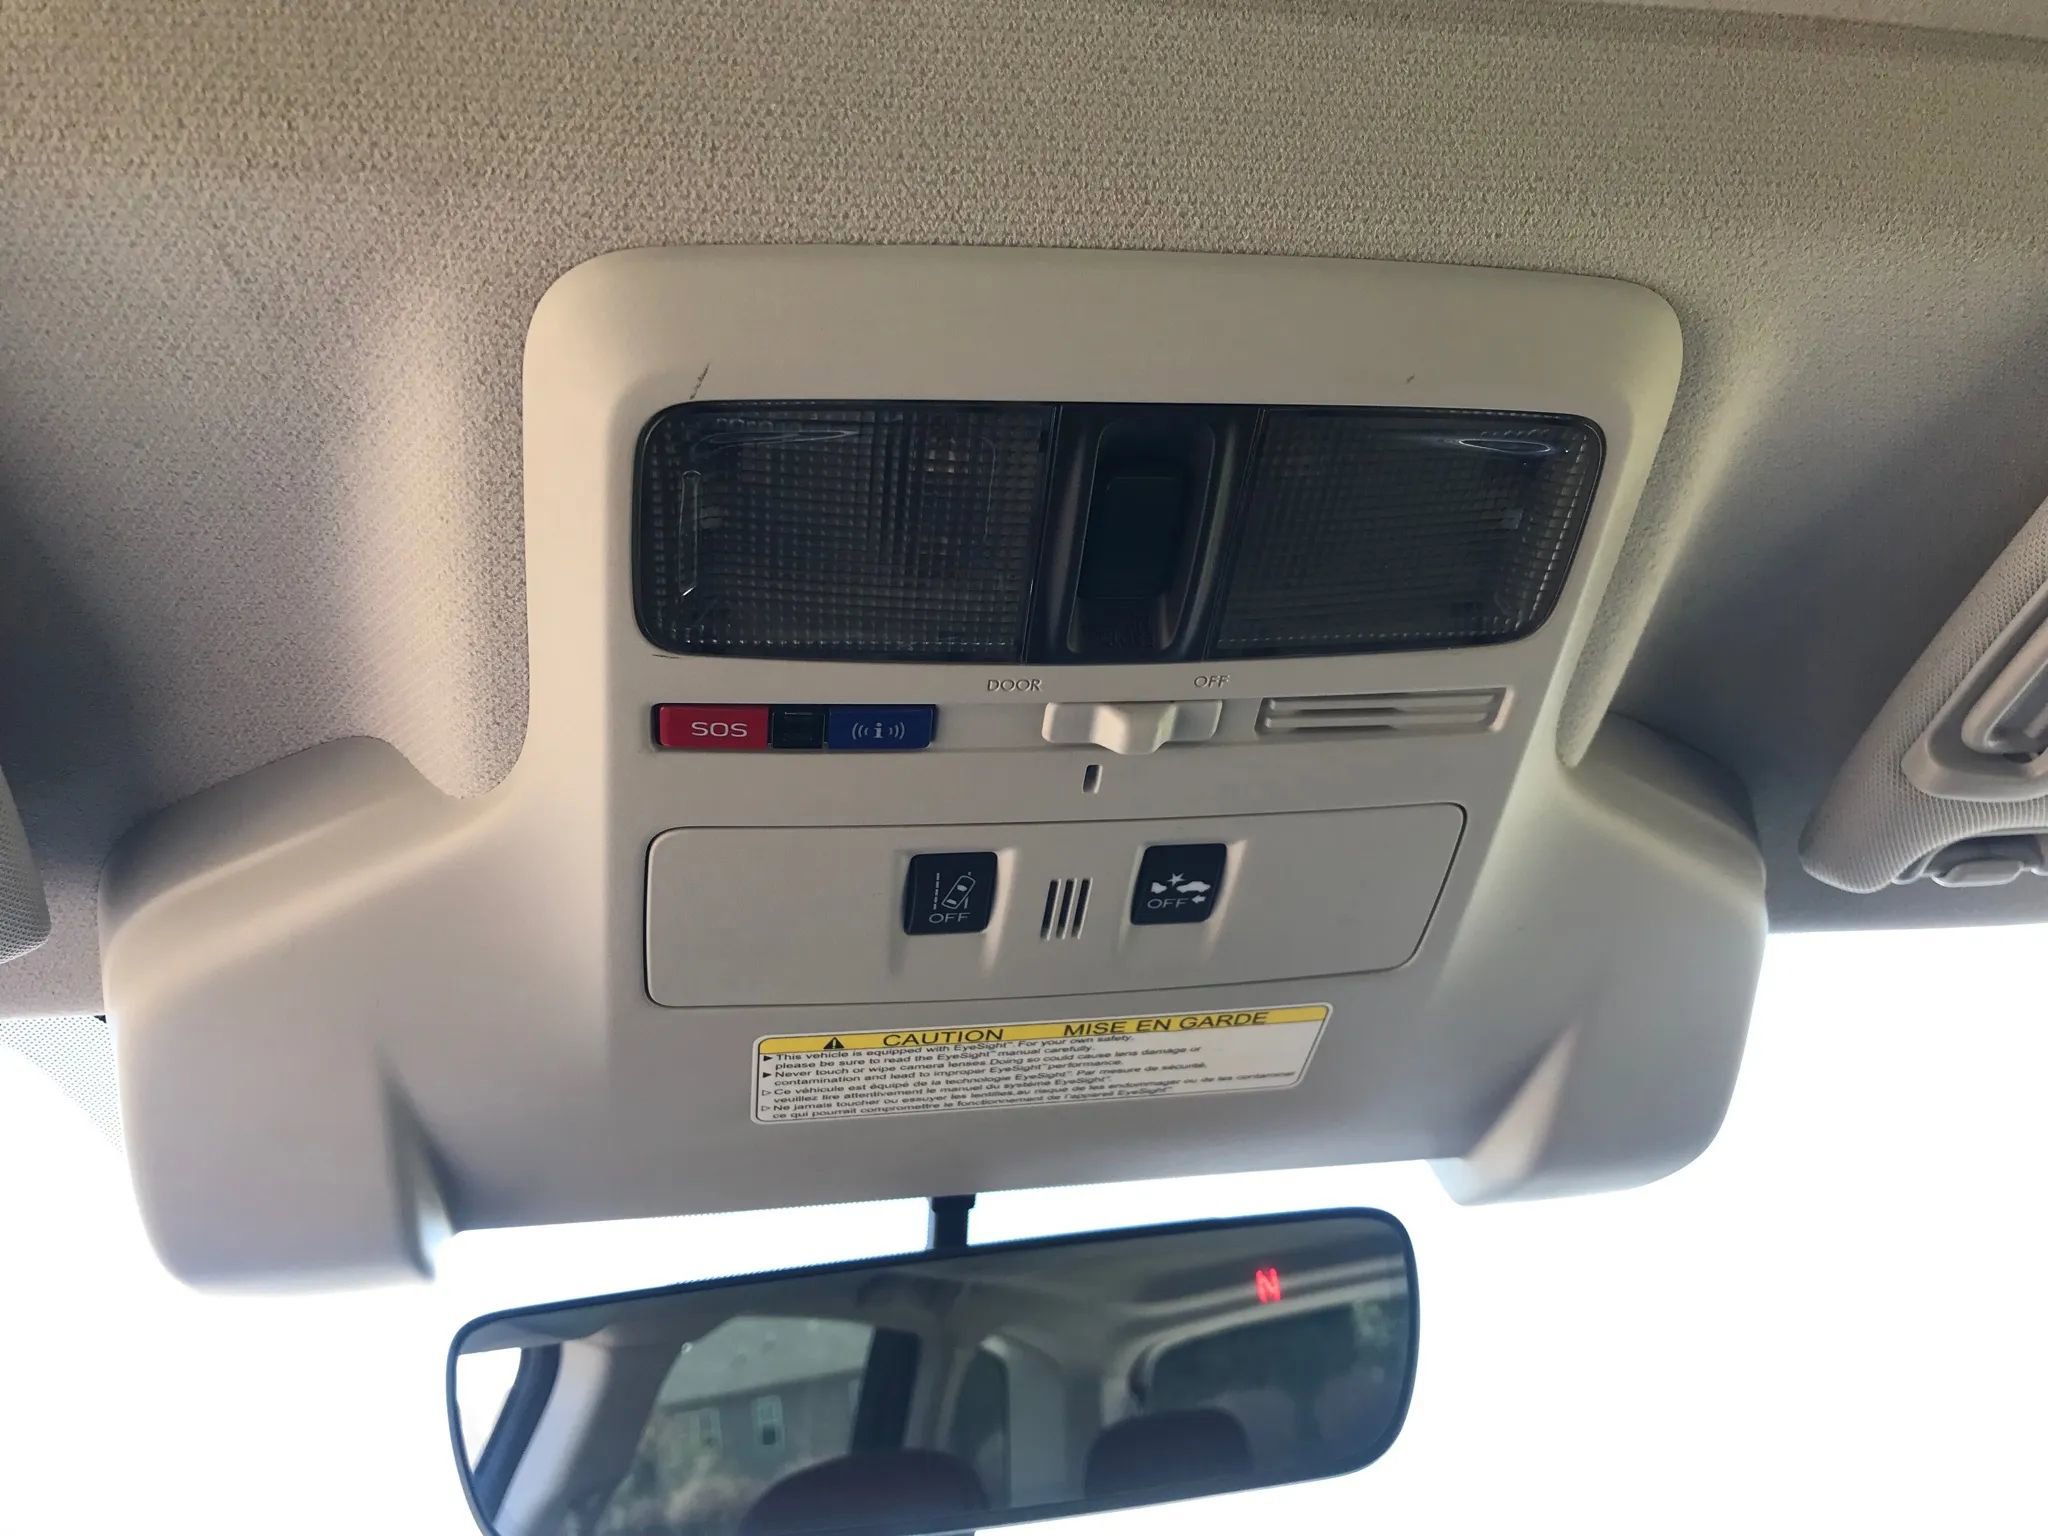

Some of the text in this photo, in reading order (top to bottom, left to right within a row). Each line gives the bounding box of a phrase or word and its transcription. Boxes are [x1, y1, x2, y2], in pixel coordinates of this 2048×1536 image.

[986, 679, 1042, 692] DOOR
[1193, 675, 1229, 689] OFF
[690, 721, 749, 738] SOS
[1146, 897, 1190, 909] OFF
[928, 912, 971, 924] OFF
[882, 1012, 1270, 1047] CAUTION MISE EN GARDE
[806, 1051, 849, 1060] vehicle
[866, 1047, 922, 1057] equipped
[926, 1045, 950, 1053] with
[1018, 1039, 1038, 1047] For
[1041, 1038, 1067, 1047] your
[775, 1062, 816, 1071] please
[869, 1057, 880, 1065] to
[884, 1055, 911, 1064] read
[998, 1048, 1041, 1057] manual
[815, 1067, 849, 1076] touch
[869, 1065, 896, 1073] wipe
[900, 1063, 945, 1071] camera
[990, 1057, 1024, 1066] Doing
[1043, 1054, 1075, 1062] could
[1077, 1052, 1112, 1060] cause
[1115, 1050, 1139, 1058] lens
[1141, 1047, 1187, 1056] damage
[774, 1075, 861, 1087] contamination
[864, 1073, 887, 1081] and
[890, 1071, 916, 1080] lead
[934, 1068, 987, 1078] improper
[774, 1088, 791, 1096] Ce
[913, 1080, 928, 1088] de
[774, 1095, 818, 1103] veuillez
[773, 1104, 791, 1112] Ne
[1254, 1267, 1281, 1304] N
